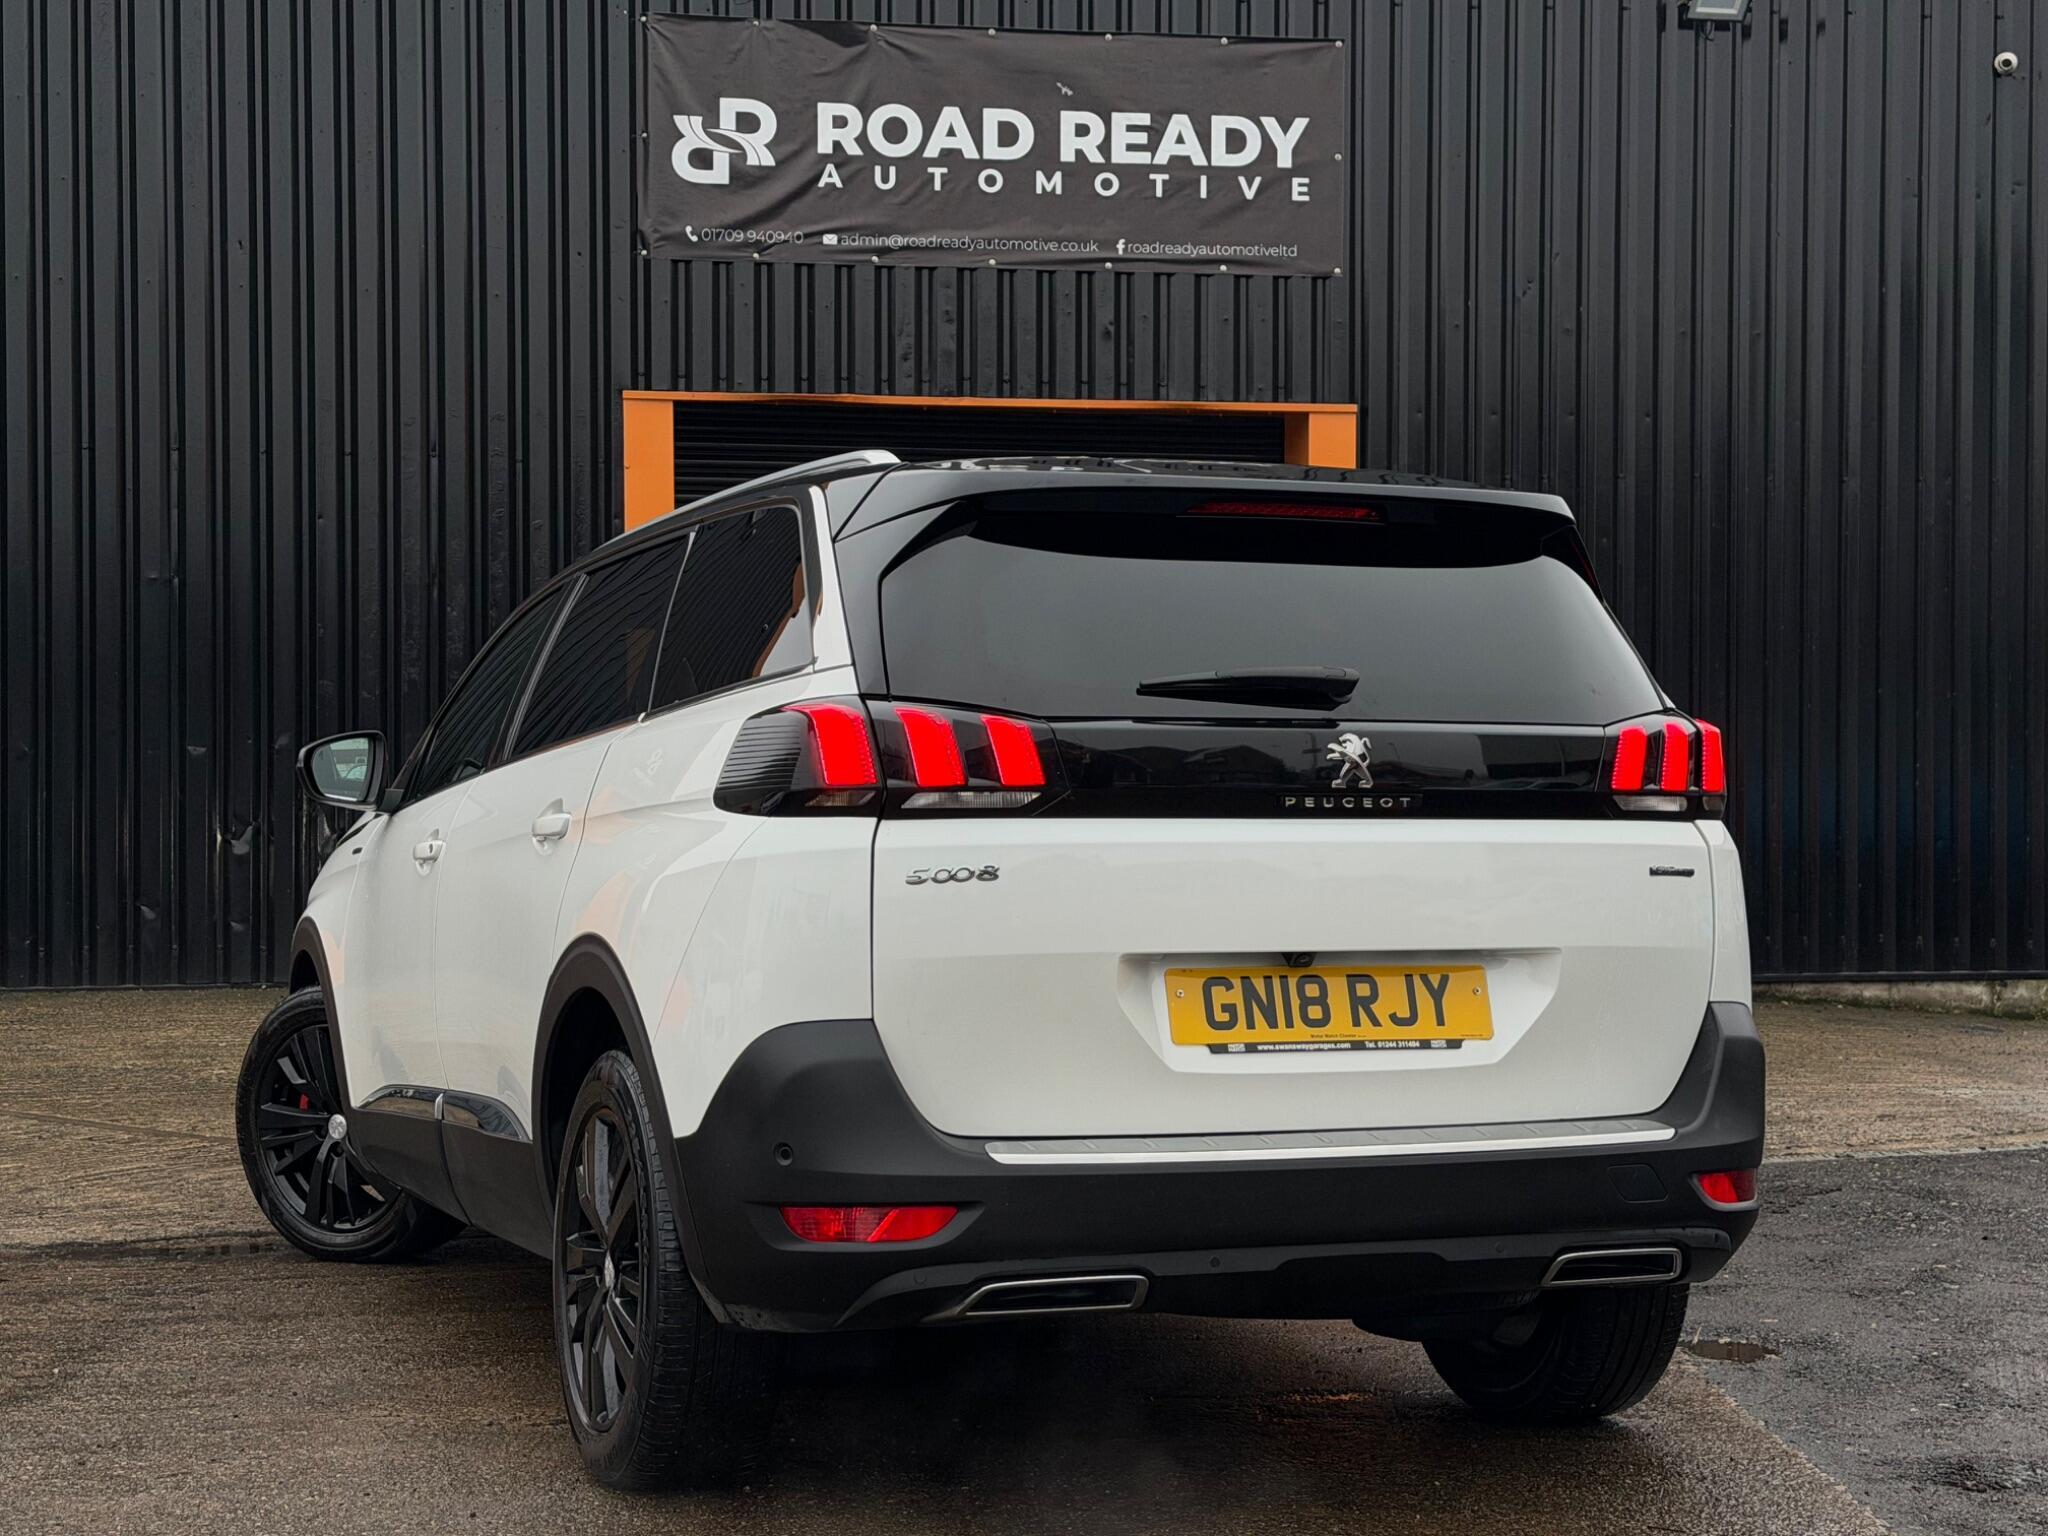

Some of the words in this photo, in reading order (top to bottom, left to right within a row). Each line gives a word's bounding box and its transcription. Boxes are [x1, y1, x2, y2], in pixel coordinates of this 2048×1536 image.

[817, 102, 1035, 161] ROAD
[1060, 110, 1310, 169] READY
[817, 163, 1310, 202] AUTOMOTIVE
[701, 227, 744, 243] 01709
[747, 230, 804, 245] 940940
[840, 232, 1099, 253] admin@roadreadyautomotive.co.uk
[1127, 241, 1298, 258] roadreadyautomotiveltd
[1284, 796, 1412, 808] PEUGEOT
[904, 864, 1000, 886] 5008
[1201, 973, 1333, 1031] GN18
[1344, 972, 1451, 1029] RJY
